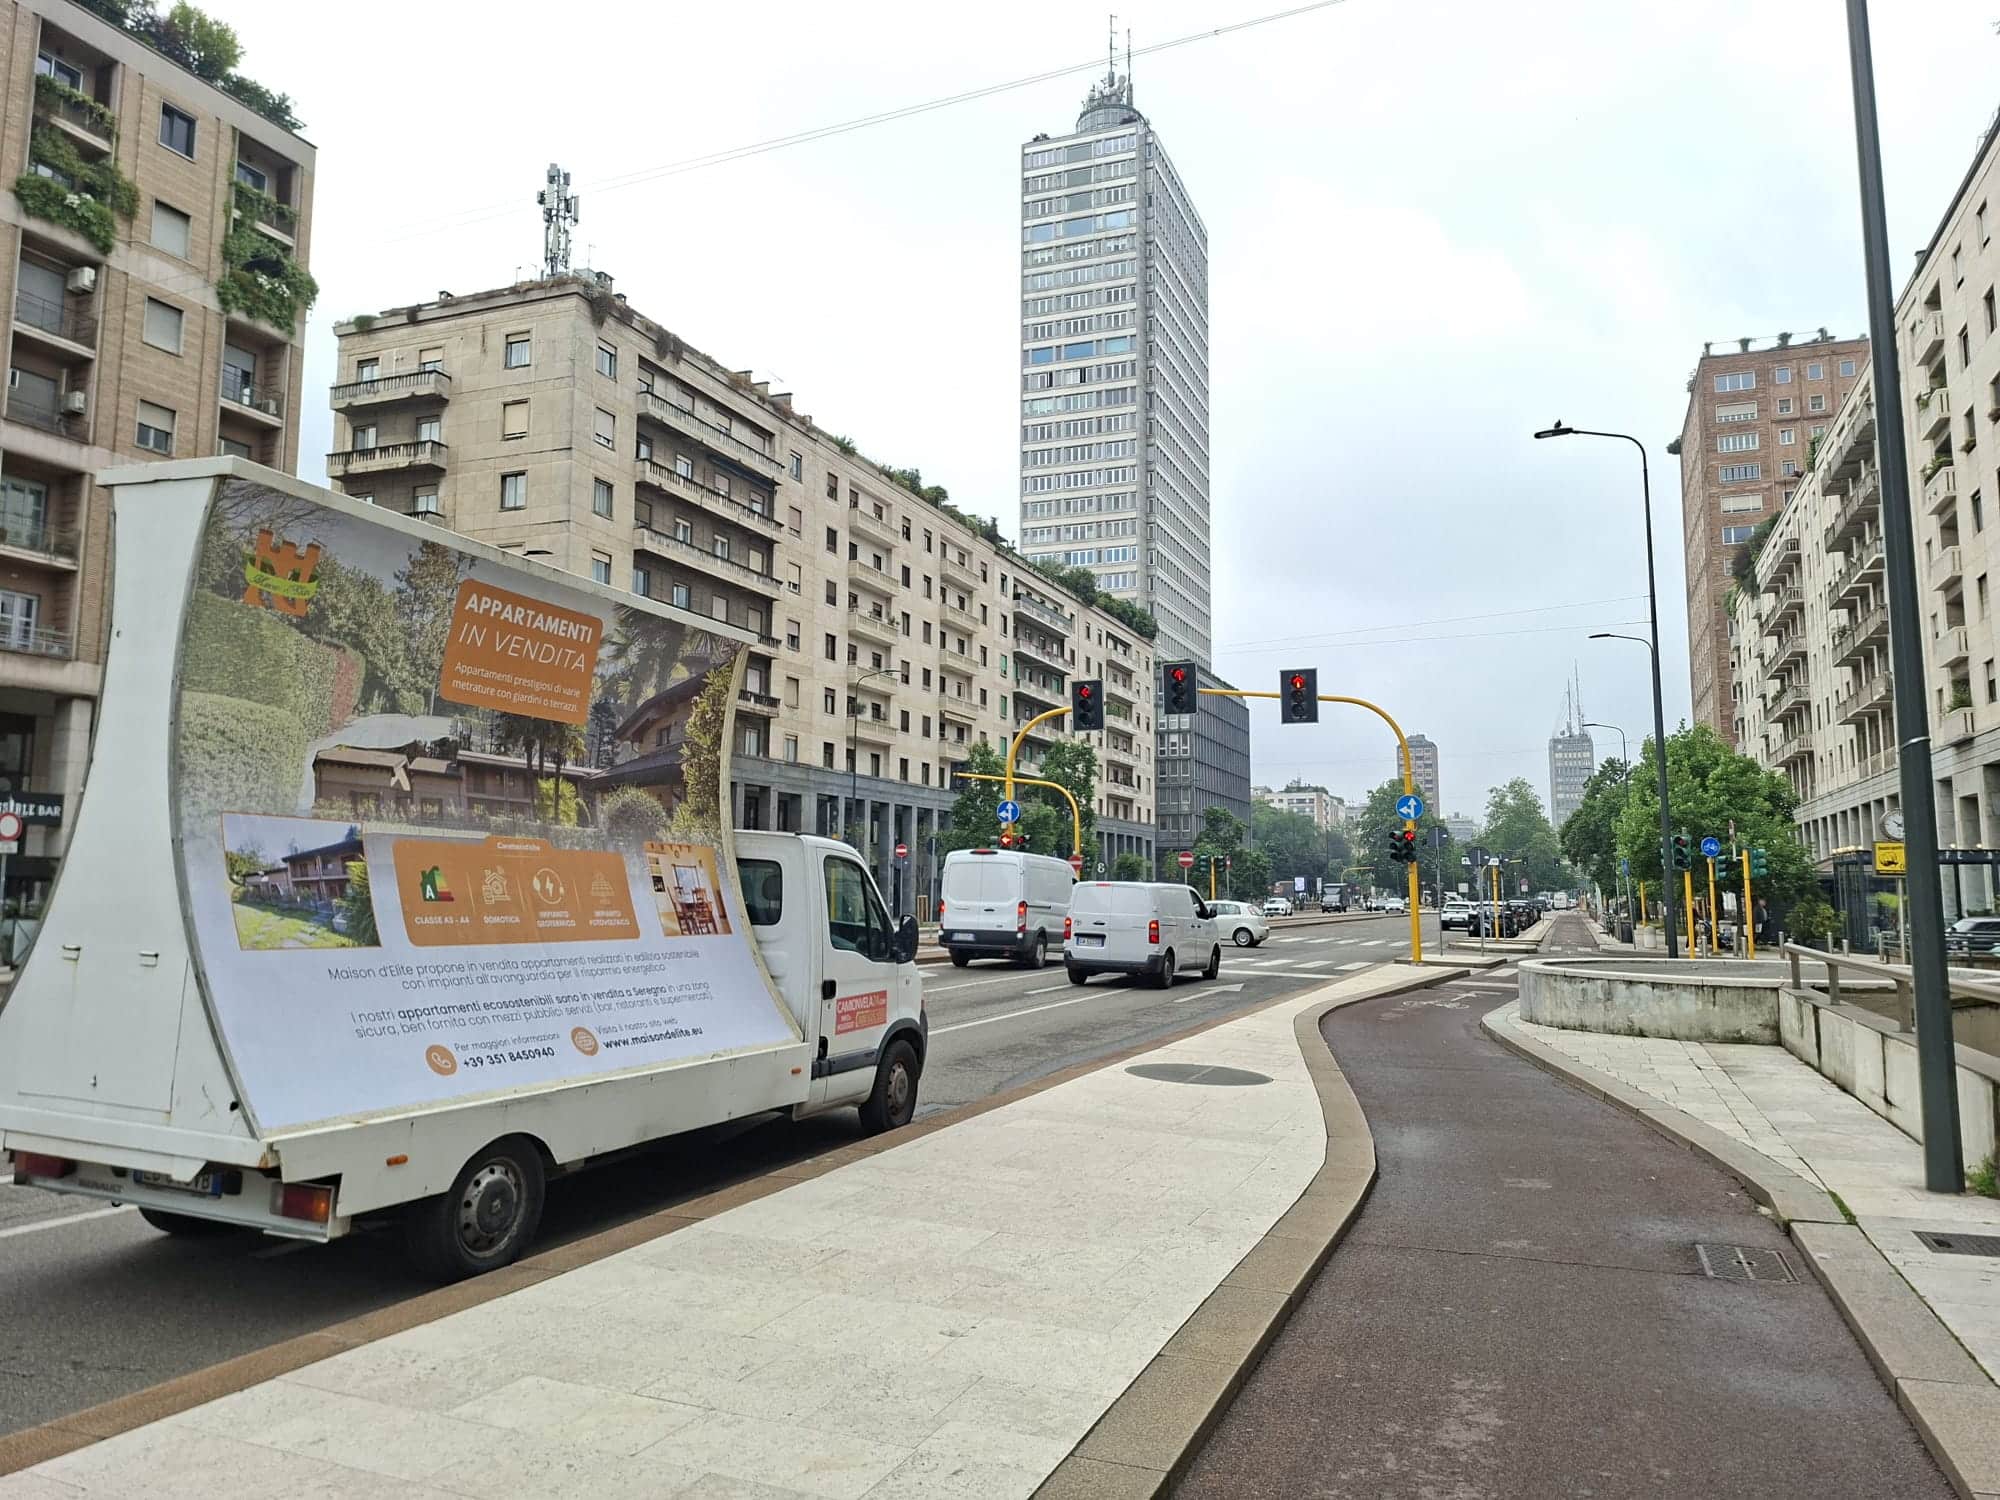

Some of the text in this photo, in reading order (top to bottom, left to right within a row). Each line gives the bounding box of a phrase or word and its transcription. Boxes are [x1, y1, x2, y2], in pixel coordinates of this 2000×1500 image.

[465, 593, 592, 644] APPARTAMENTI
[458, 622, 586, 673] IN VENDITA
[454, 662, 581, 698] Appartamenti prestigiosi di varie
[452, 679, 496, 696] metrature
[497, 689, 512, 699] con
[512, 690, 542, 705] giardini
[550, 700, 579, 713] terrazzi.
[38, 804, 61, 817] BAR
[425, 885, 435, 899] A
[414, 916, 444, 924] CLASSE
[328, 950, 700, 980] Maison d'Elite propone in vendita appartamenti realizzati in edilizia sostenibile
[402, 963, 666, 990] con impianti all'avanguardia per il risparmio energetico
[350, 982, 710, 1024] I nostri appartamenti ecosostenibili sono in vendita a Seregno in una zona
[354, 1024, 400, 1039] sicura,
[400, 1020, 426, 1034] ben
[427, 1017, 466, 1032] fornita
[468, 1016, 491, 1026] con
[492, 1012, 521, 1023] mezzi
[523, 1007, 564, 1022] pubblici
[564, 1005, 592, 1016] servizi
[616, 998, 652, 1010] ristoranti
[596, 1024, 618, 1036] Visita
[624, 1022, 648, 1031] nostro
[649, 1018, 662, 1028] sito
[662, 1017, 678, 1026] web
[454, 1032, 560, 1052] Per maggiori informazioni
[603, 1026, 704, 1049] www.maisondelite.eu
[463, 1046, 556, 1068] +39 351 8450940
